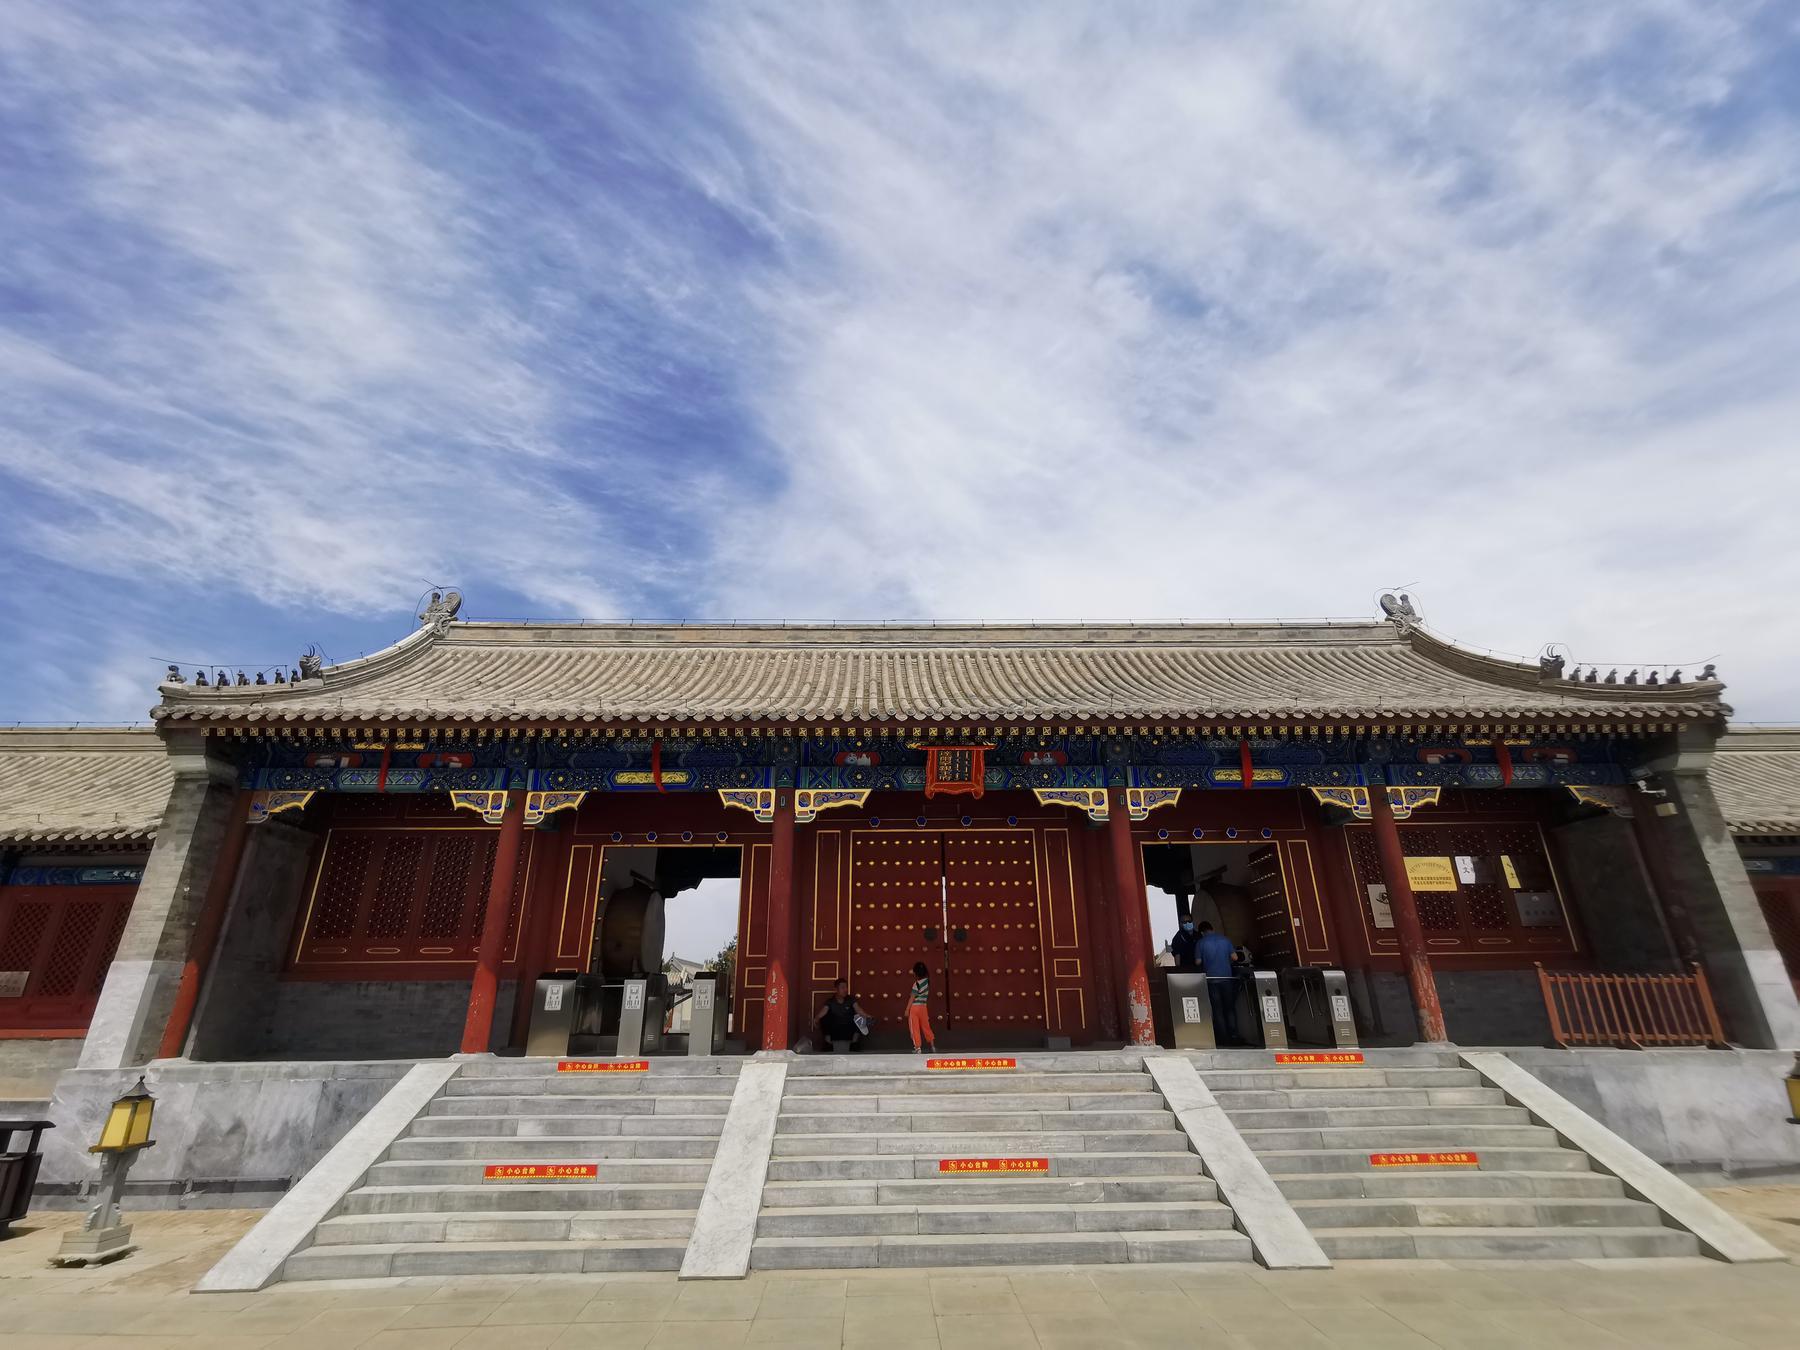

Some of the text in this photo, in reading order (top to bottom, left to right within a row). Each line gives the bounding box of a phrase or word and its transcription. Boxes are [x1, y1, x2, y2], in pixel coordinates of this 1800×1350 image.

[960, 1160, 1039, 1169] 小心台阶 小心台阶
[506, 1166, 587, 1175] 小心台阶 小心台阶
